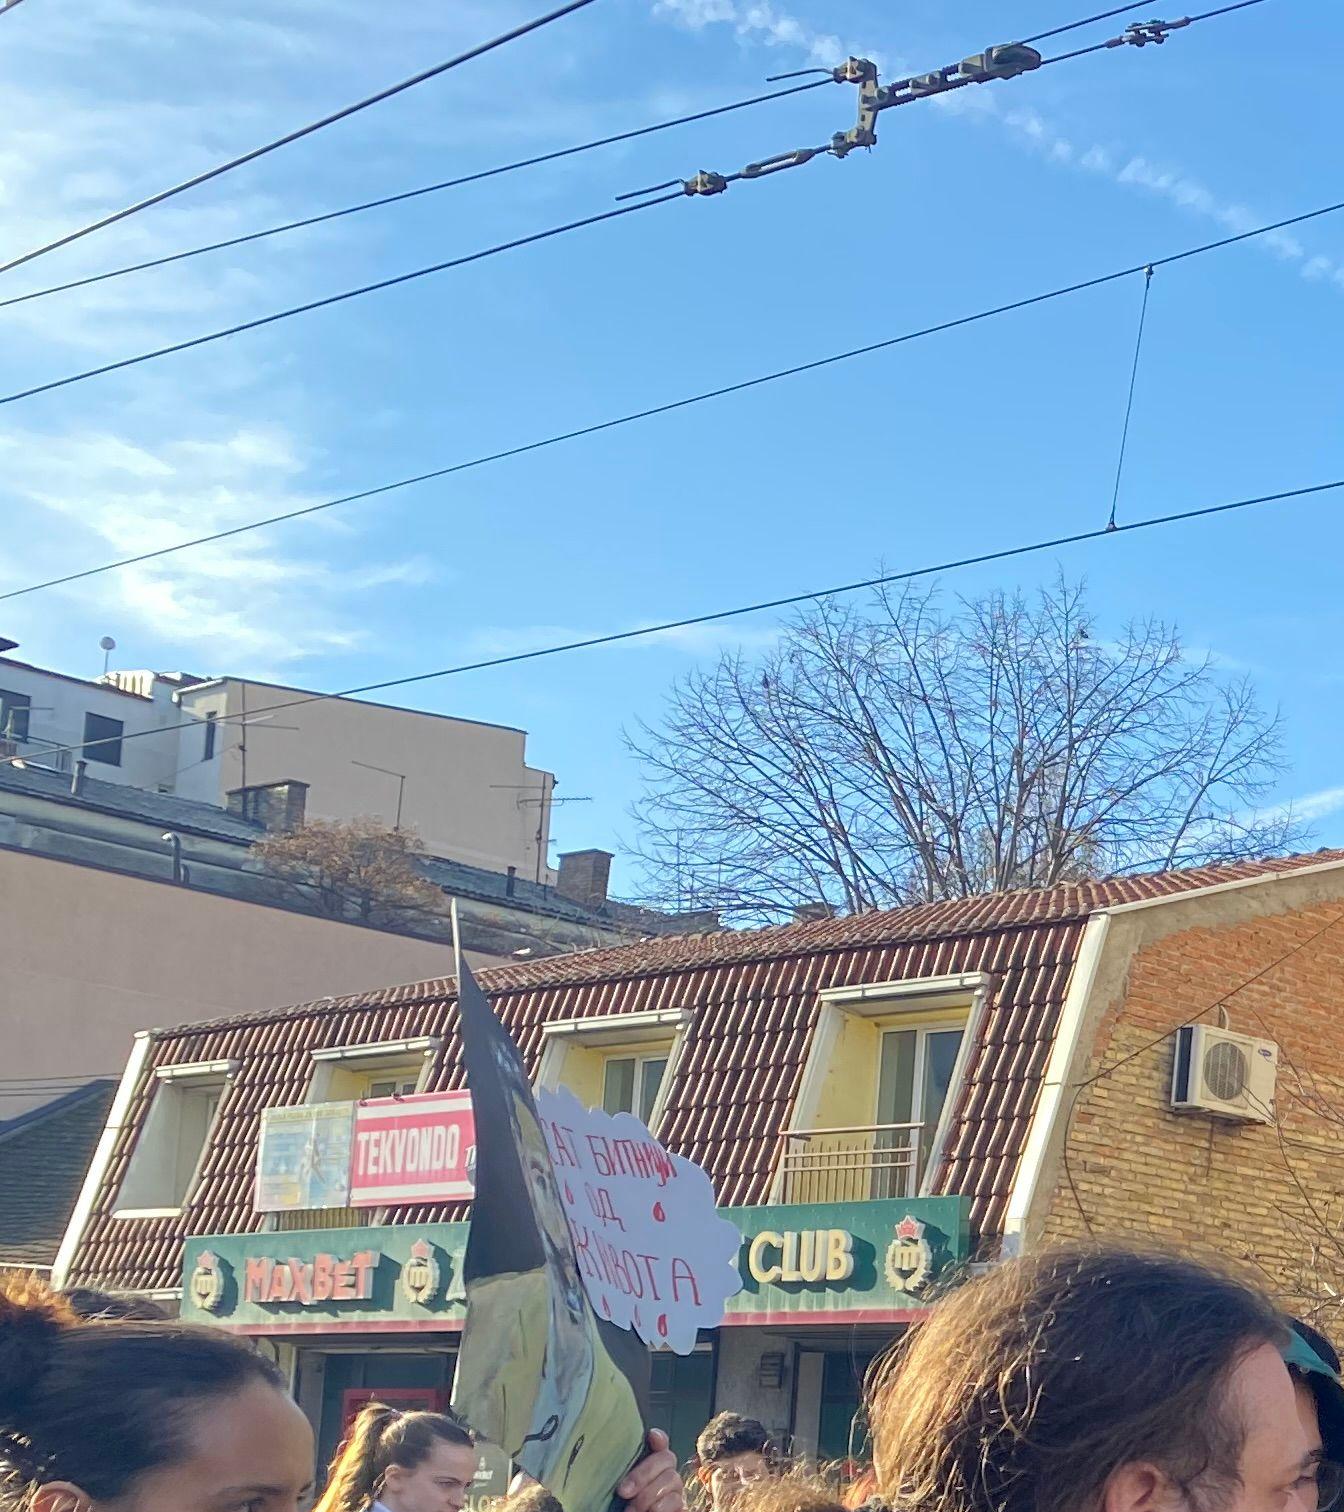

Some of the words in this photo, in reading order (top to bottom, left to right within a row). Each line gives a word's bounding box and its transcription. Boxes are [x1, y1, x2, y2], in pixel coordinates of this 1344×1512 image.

[357, 1123, 460, 1176] TEKVONDO
[244, 1250, 382, 1305] MAXBET
[748, 1229, 854, 1284] CLUB
